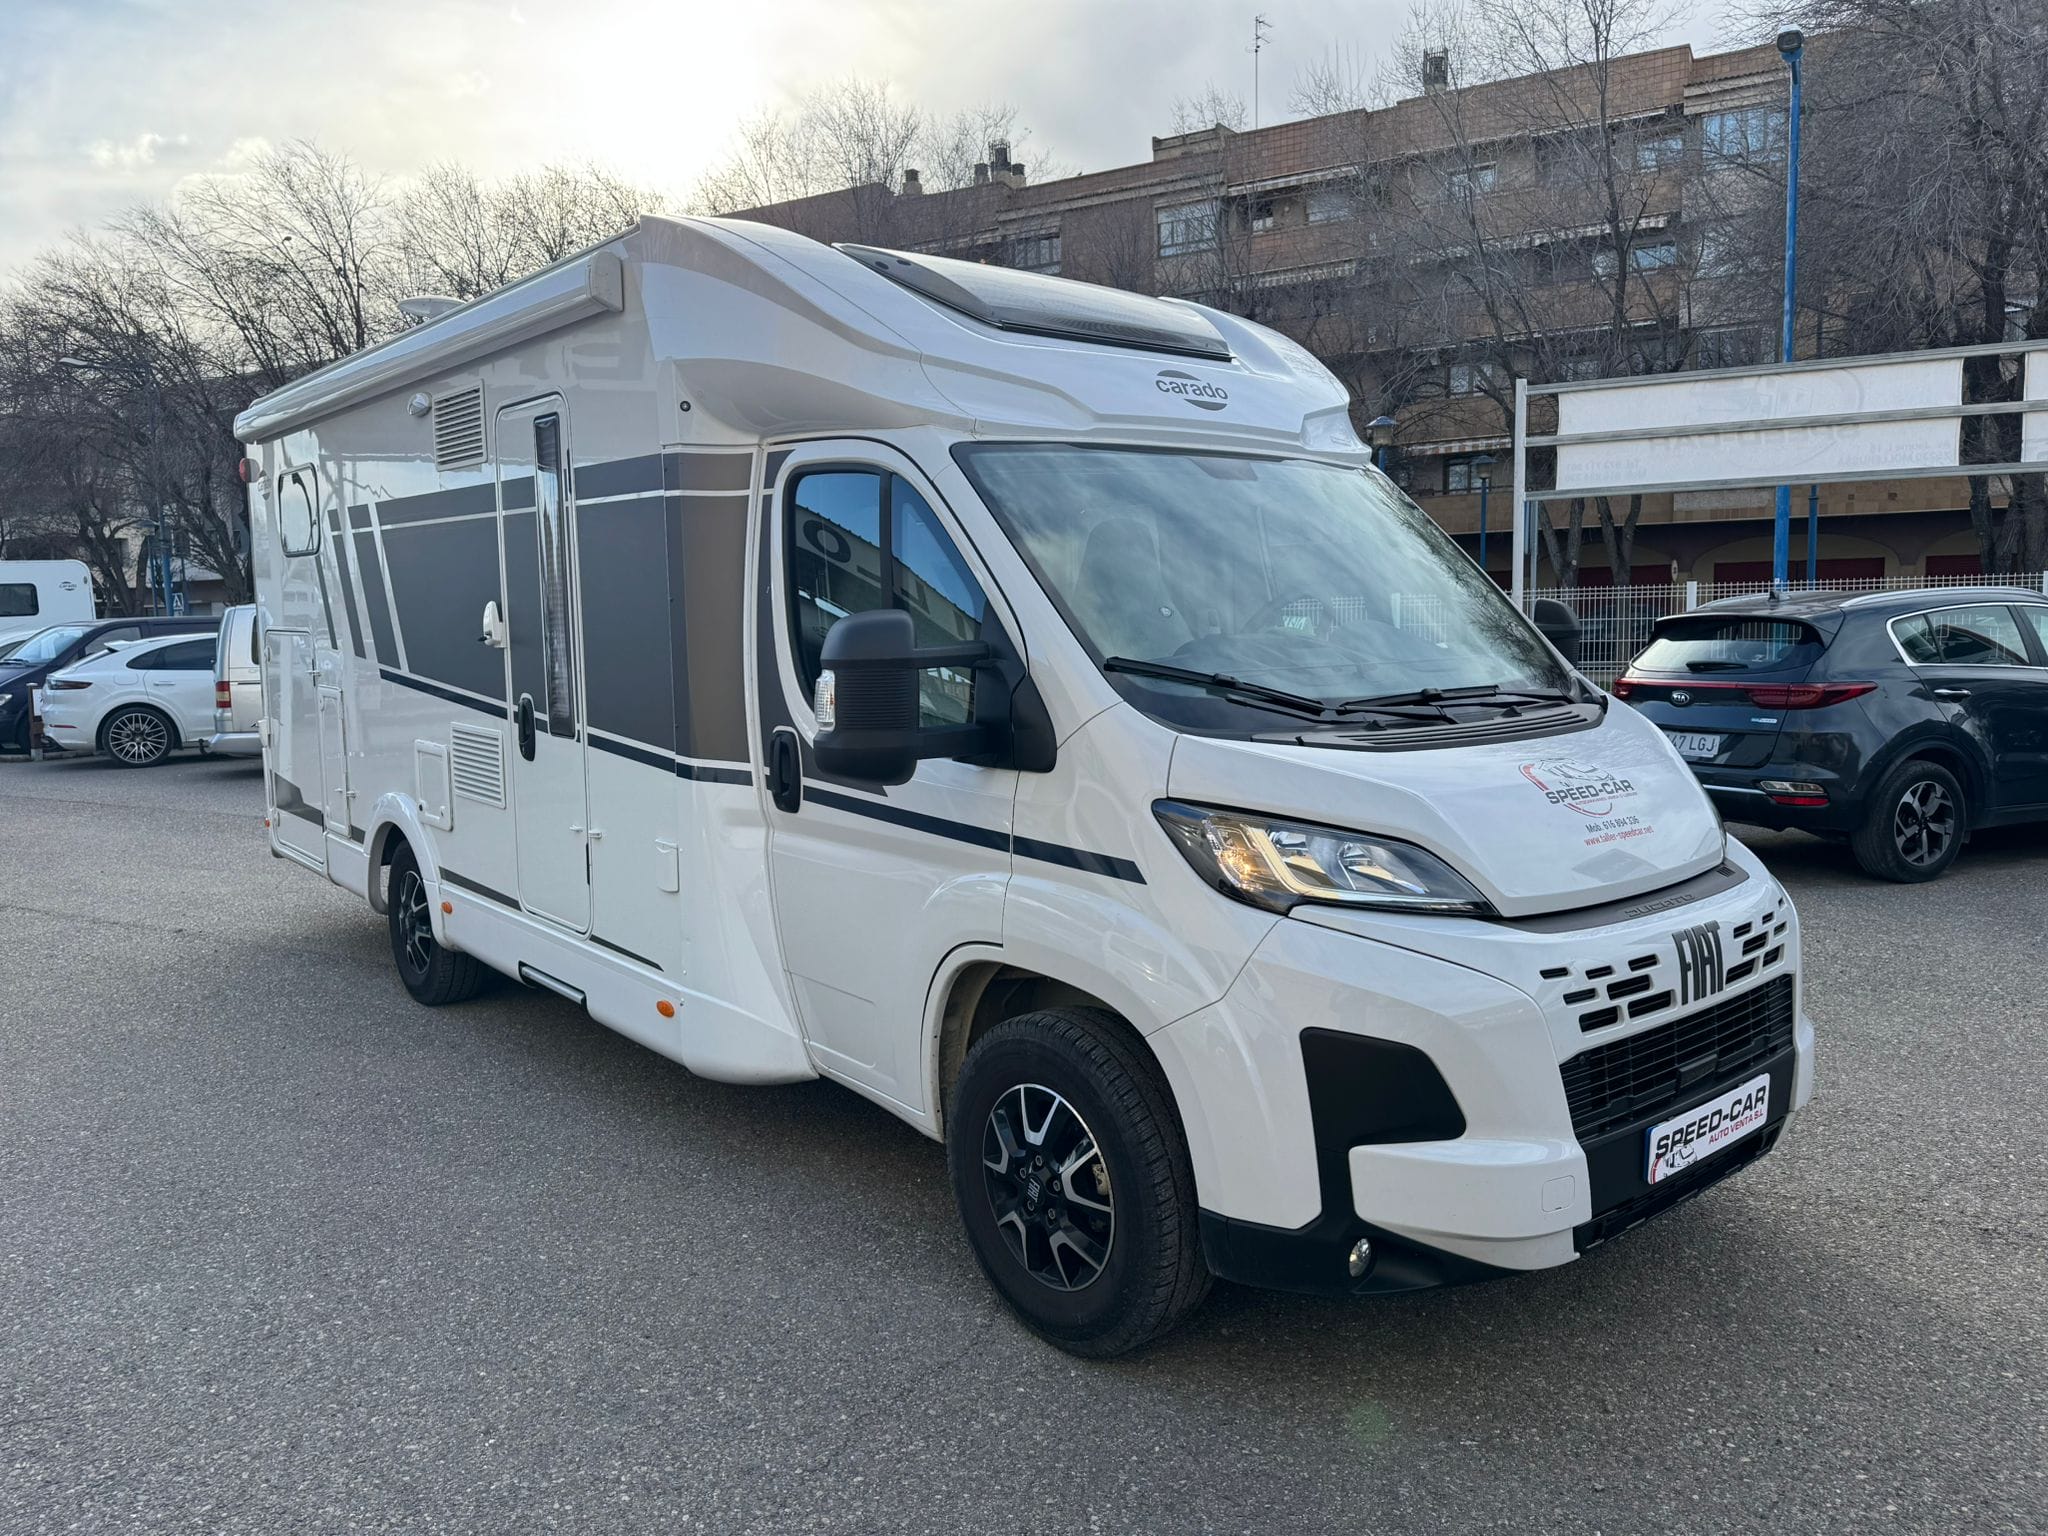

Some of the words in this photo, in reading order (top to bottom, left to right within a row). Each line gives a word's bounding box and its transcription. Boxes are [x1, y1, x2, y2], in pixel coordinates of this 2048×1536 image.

[1155, 379, 1229, 400] carado
[1689, 735, 1715, 751] LGJ
[1546, 780, 1634, 804] SPEED-CAR
[1672, 920, 1723, 1006] FIAT
[1656, 1085, 1766, 1160] SPEED-CAR
[1709, 1127, 1729, 1144] AUTO
[1730, 1114, 1753, 1132] VENTA
